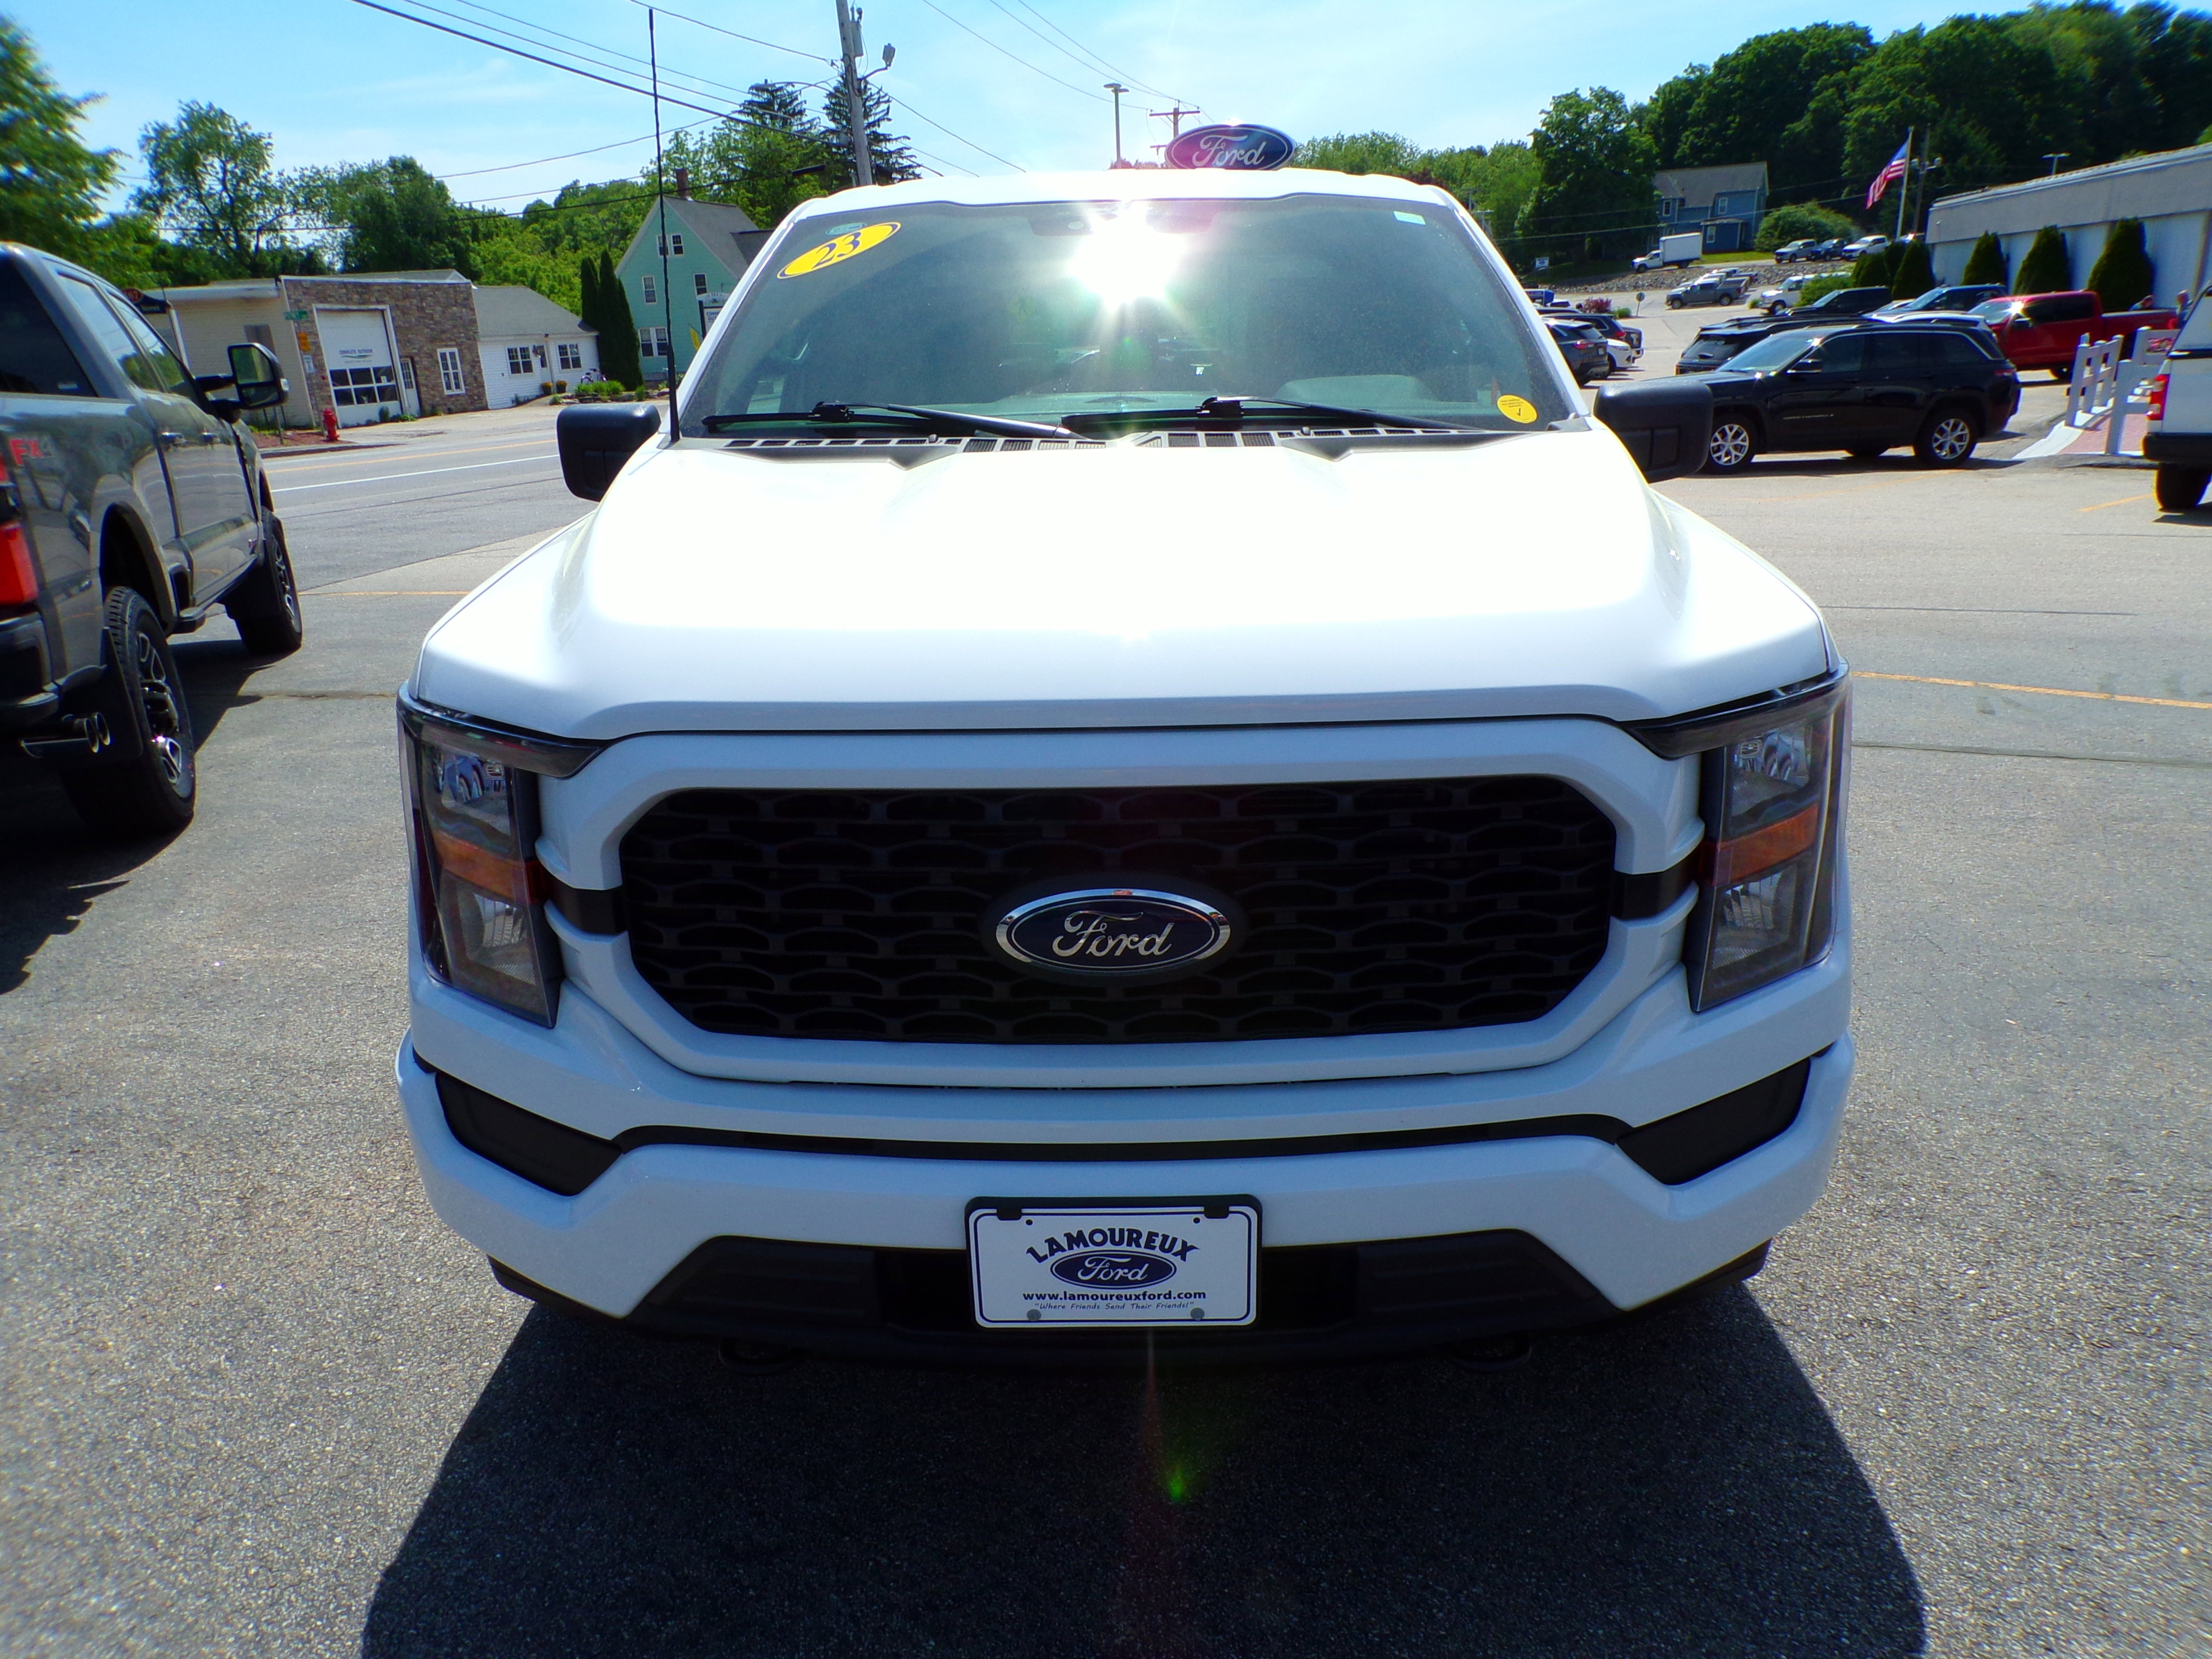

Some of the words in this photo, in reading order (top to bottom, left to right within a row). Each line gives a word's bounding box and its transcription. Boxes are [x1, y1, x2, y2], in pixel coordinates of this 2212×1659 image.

[1191, 134, 1266, 167] Ford
[811, 232, 862, 269] 23
[10, 438, 53, 466] FX4
[1052, 910, 1175, 958] Ford
[1026, 1227, 1200, 1263] LAMOUREUX
[1077, 1256, 1149, 1282] Ford
[1022, 1290, 1206, 1301] www.lamoureuxford.com
